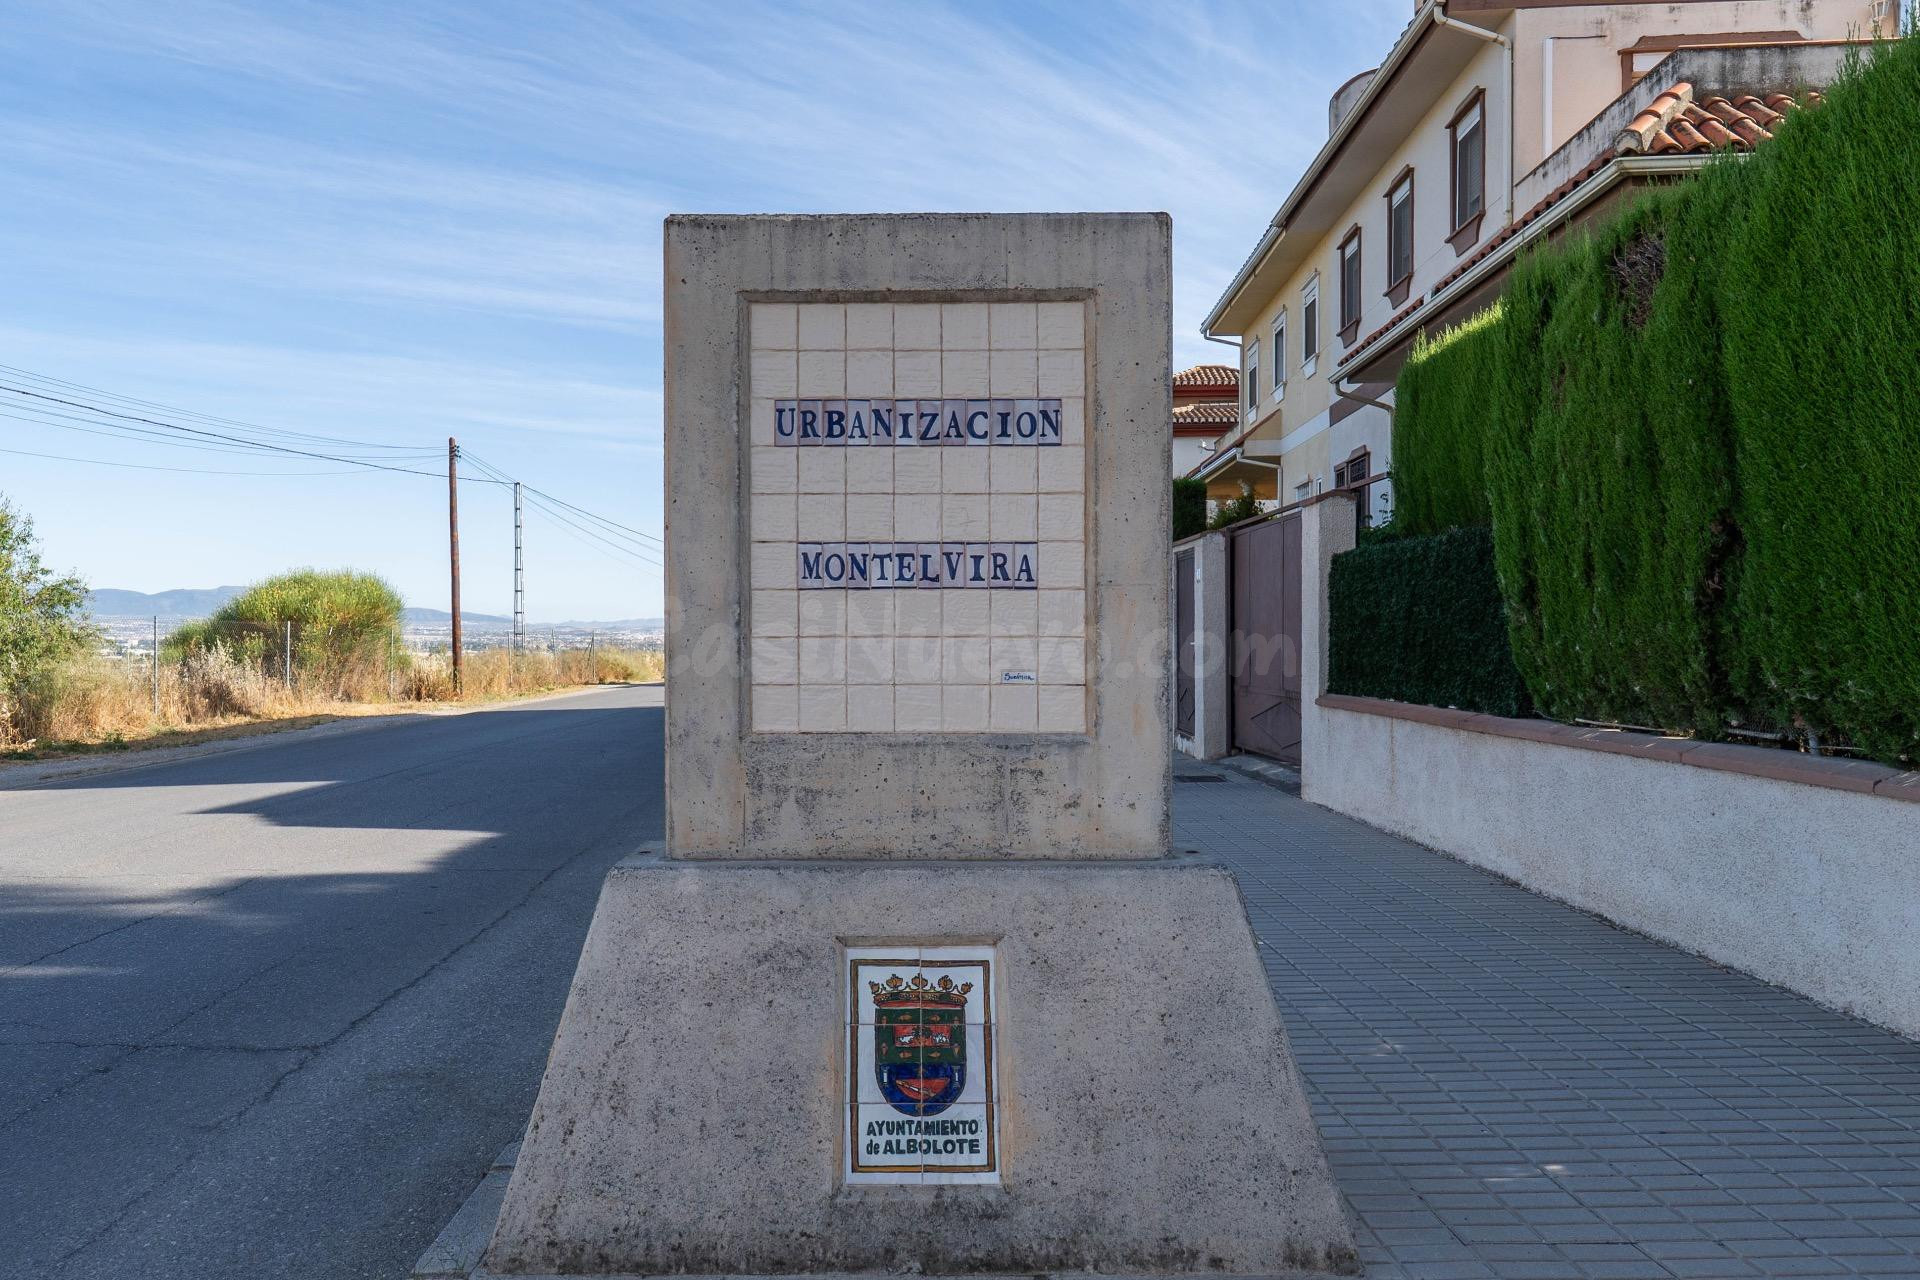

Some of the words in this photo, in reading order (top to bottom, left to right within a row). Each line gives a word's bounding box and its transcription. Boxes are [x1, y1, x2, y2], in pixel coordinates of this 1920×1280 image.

[775, 407, 1061, 441] URBANIZACION
[800, 551, 1036, 583] MONTELVIRA
[866, 1119, 979, 1137] AYUNTAMIENTO
[866, 1139, 880, 1155] de
[882, 1138, 981, 1155] ALBOLOTE
